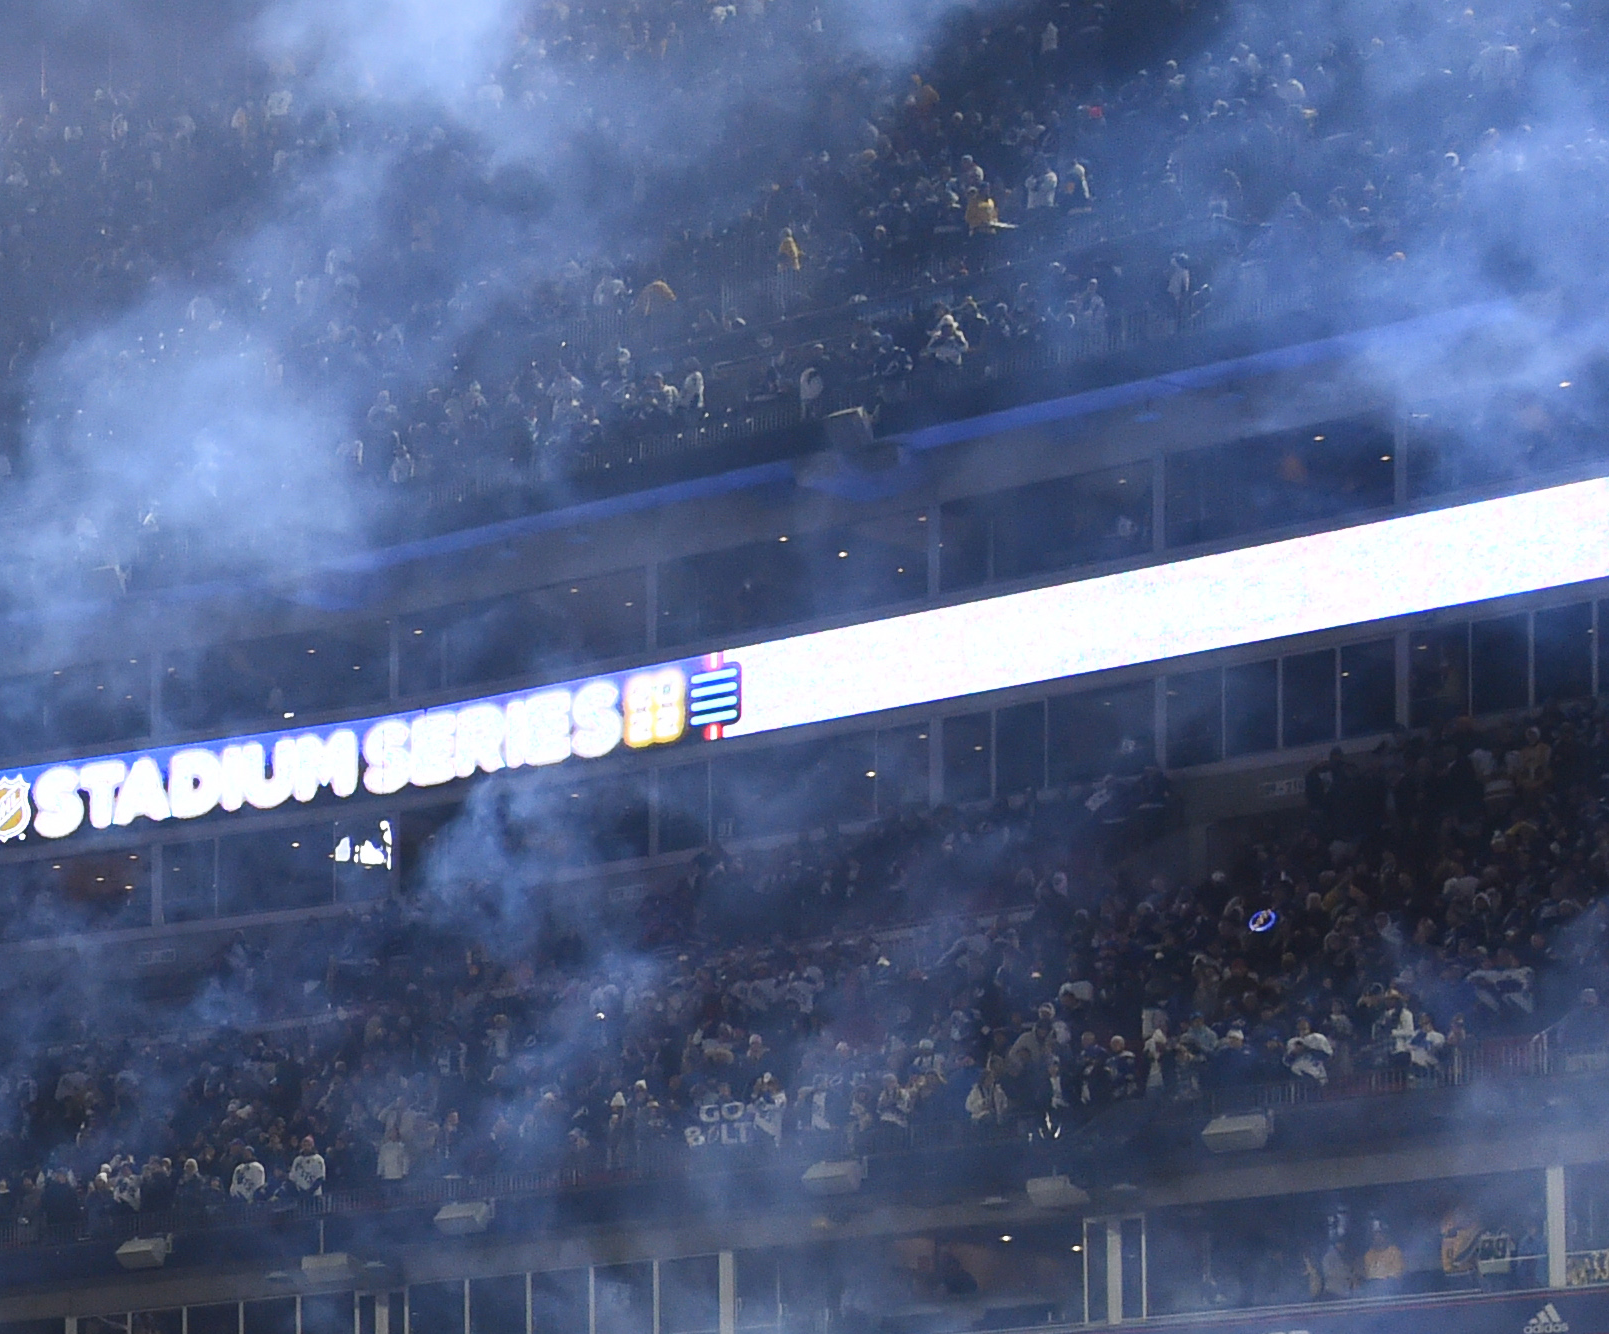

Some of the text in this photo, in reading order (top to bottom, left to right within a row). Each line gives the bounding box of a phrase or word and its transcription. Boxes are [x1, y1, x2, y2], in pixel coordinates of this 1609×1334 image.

[35, 679, 622, 839] STADIUM SERIES
[1523, 1321, 1569, 1334] adidas
